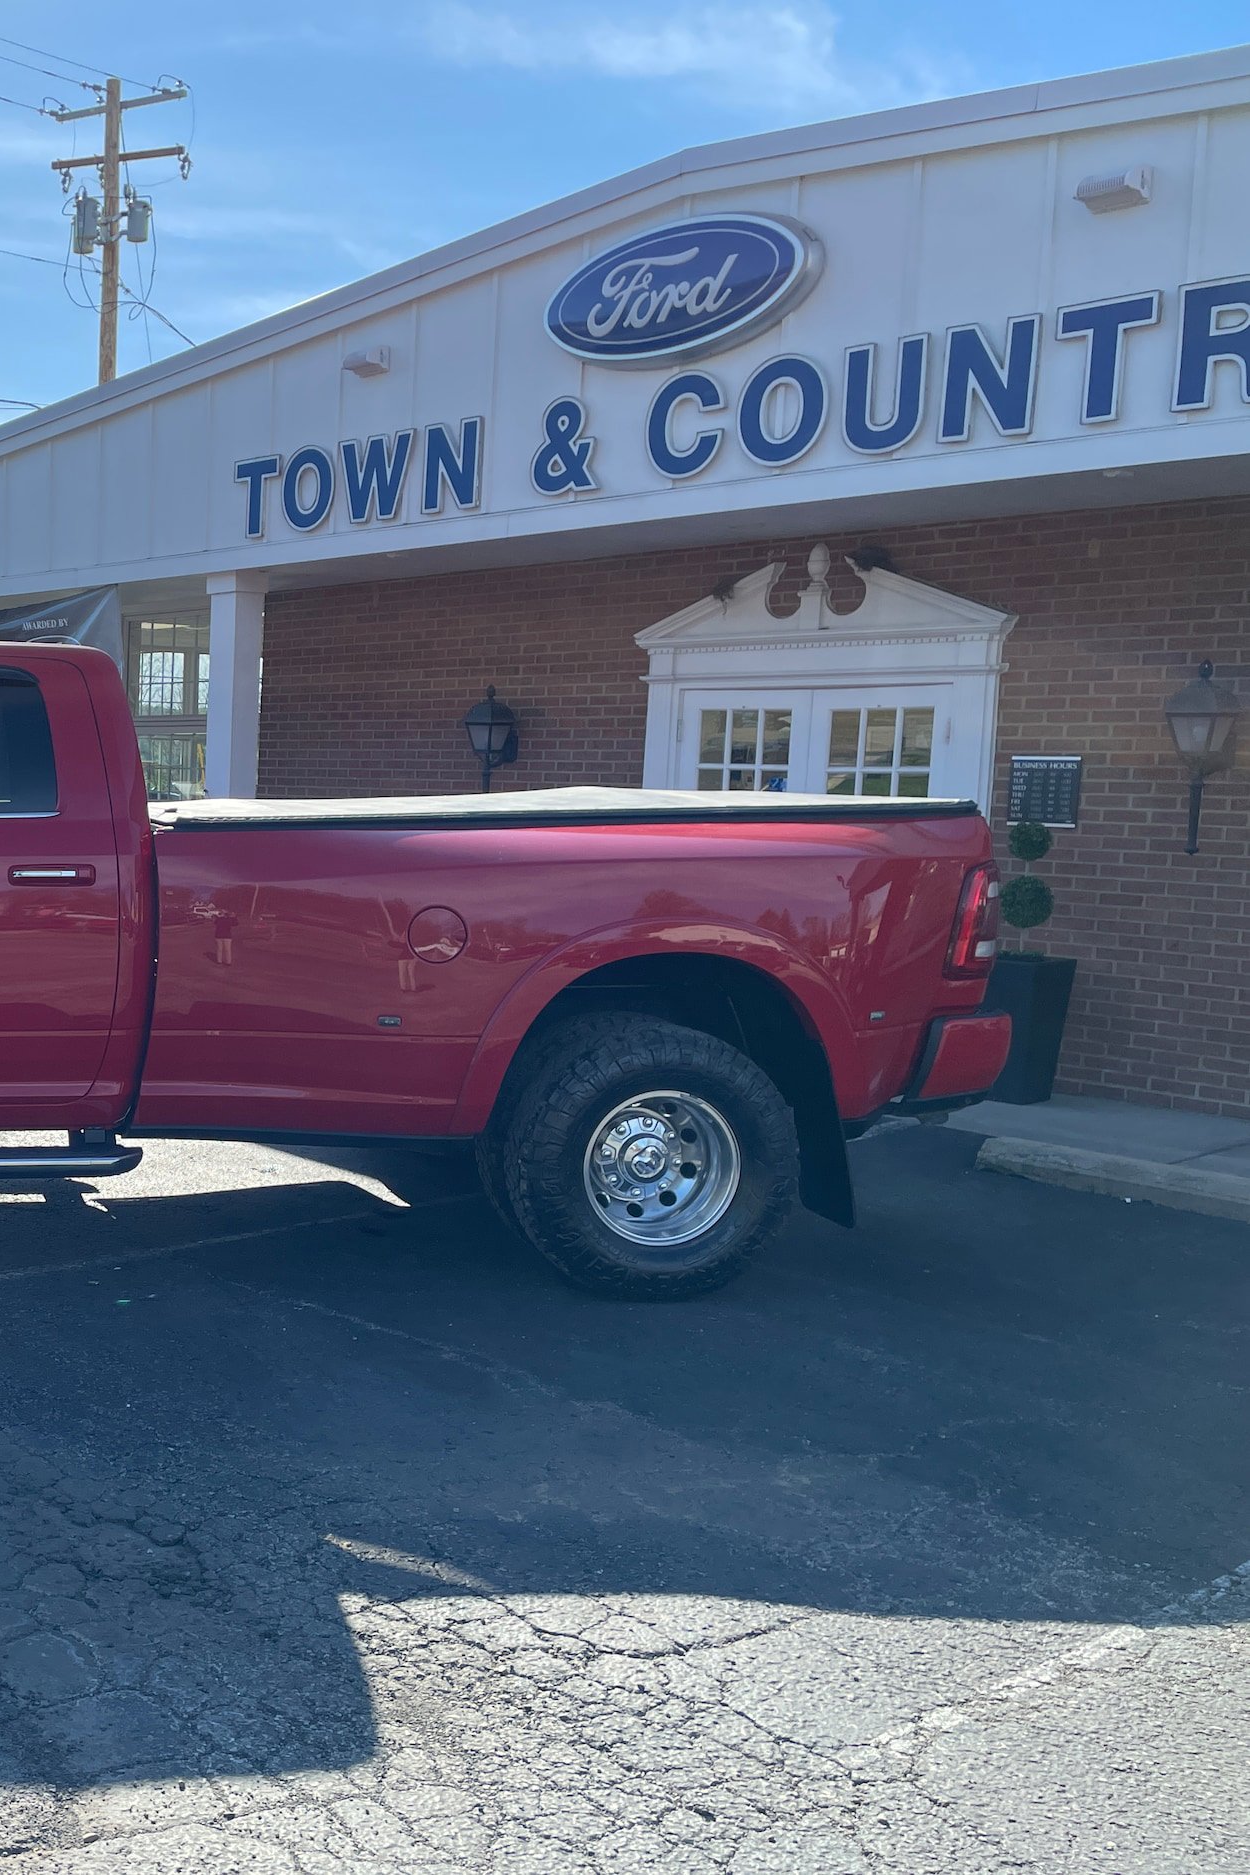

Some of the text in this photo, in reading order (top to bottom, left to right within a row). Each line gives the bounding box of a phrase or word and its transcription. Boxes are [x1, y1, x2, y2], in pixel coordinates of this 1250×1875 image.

[586, 246, 739, 338] Ford
[235, 273, 1250, 539] TOWN & COUNTR
[22, 617, 69, 631] AWARDED BY
[1049, 762, 1078, 770] HOURS
